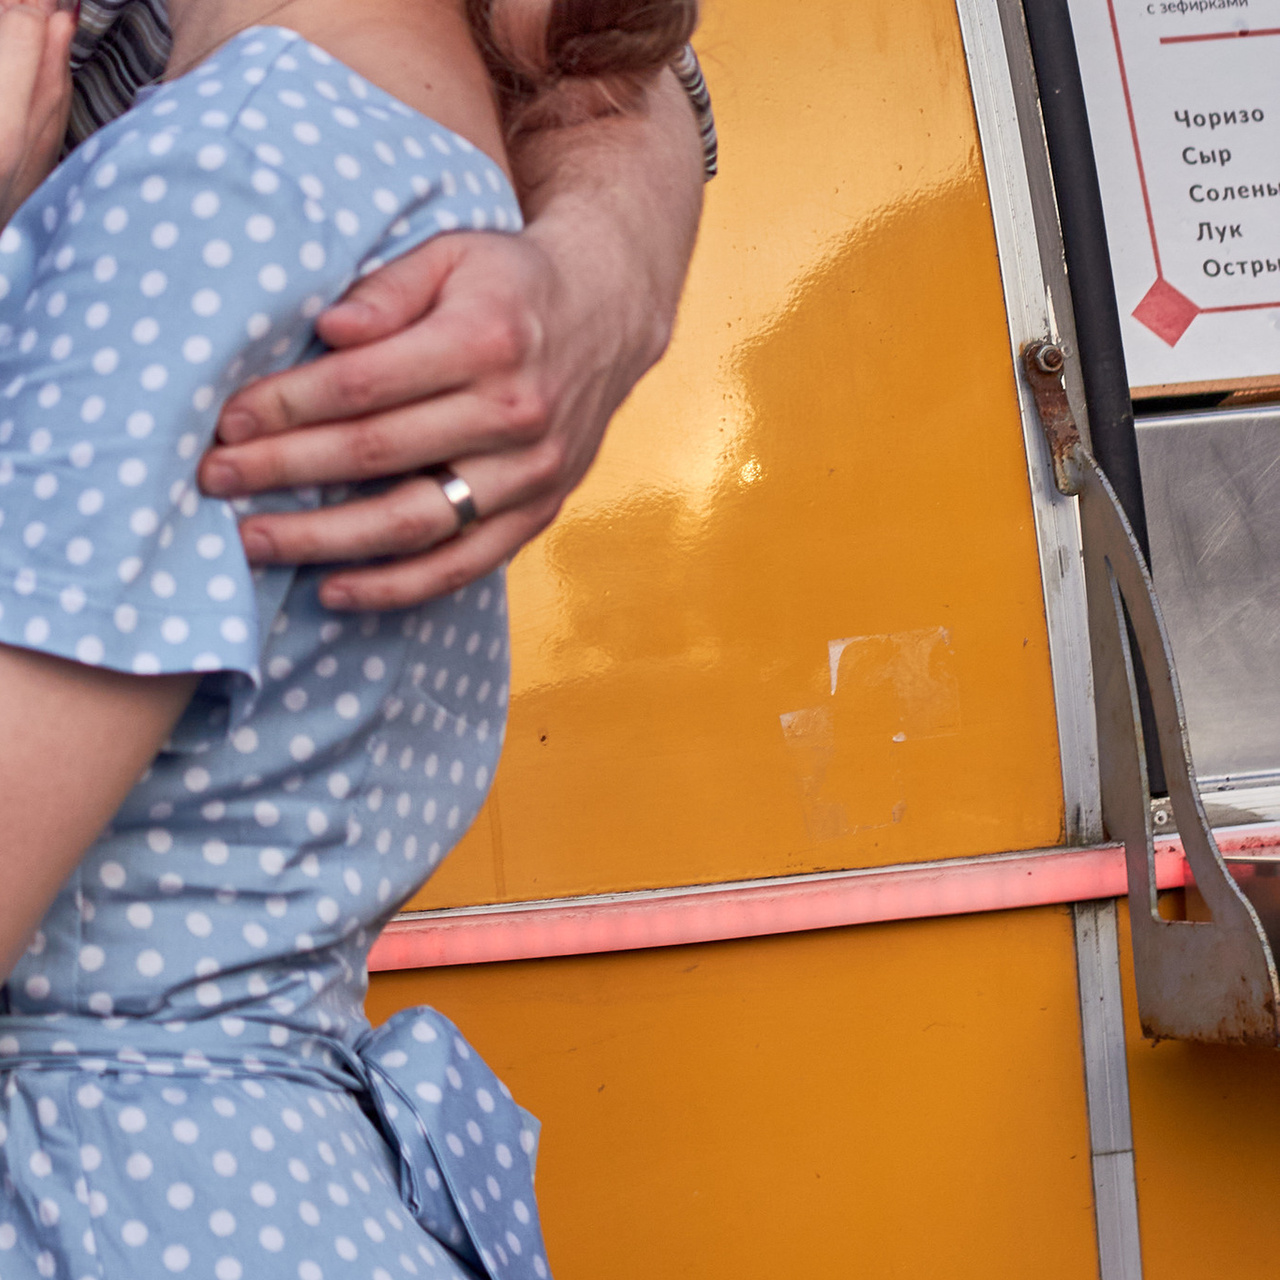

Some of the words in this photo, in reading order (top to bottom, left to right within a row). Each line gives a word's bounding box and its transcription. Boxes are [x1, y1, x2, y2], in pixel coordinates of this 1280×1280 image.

[1146, 3, 1155, 15] с
[1175, 109, 1264, 130] Чоризо
[1182, 147, 1231, 166] Сыр
[1189, 183, 1280, 202] Солены
[1197, 222, 1242, 243] Лук
